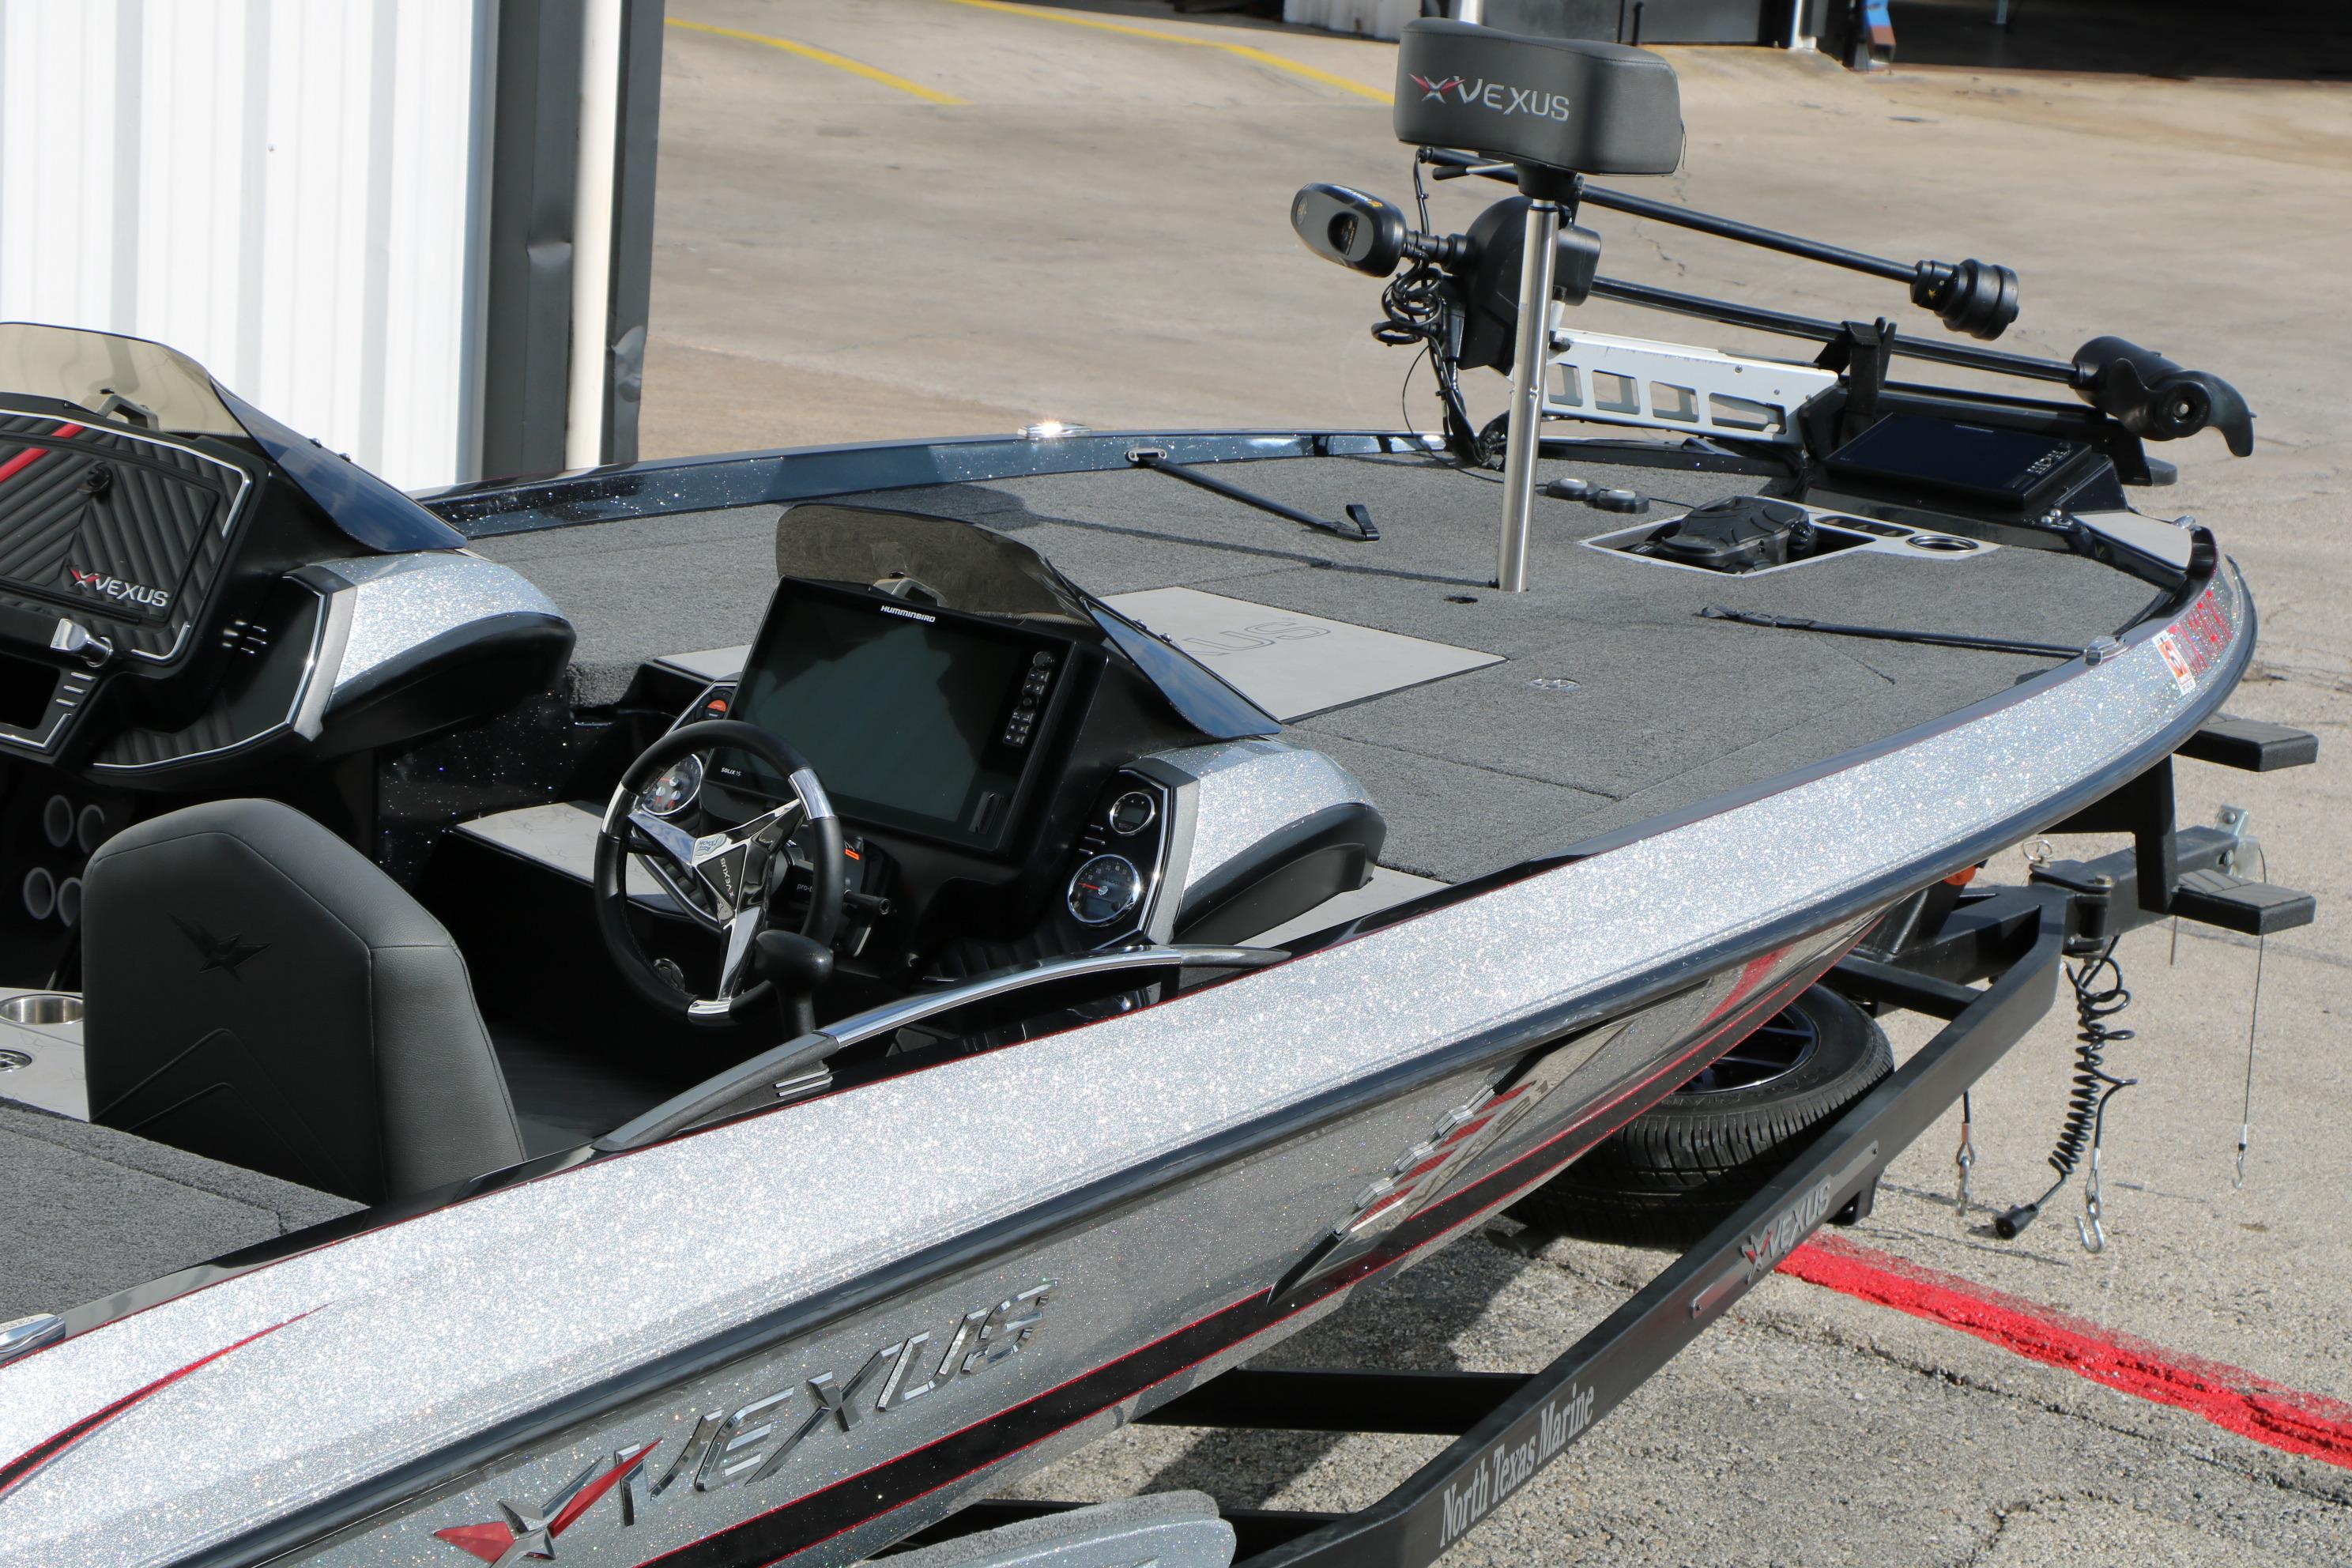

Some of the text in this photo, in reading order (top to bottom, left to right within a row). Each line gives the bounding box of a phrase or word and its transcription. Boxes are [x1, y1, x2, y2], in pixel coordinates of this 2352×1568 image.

[1453, 75, 1570, 122] VEXUS
[94, 572, 169, 607] VEXUS
[880, 605, 936, 623] HUMMINBIRD
[721, 767, 735, 775] SOLIX
[1767, 1182, 1831, 1258] VEXUS
[615, 1279, 1060, 1526] VEXUS
[1439, 1382, 1594, 1549] North Texas Marine
